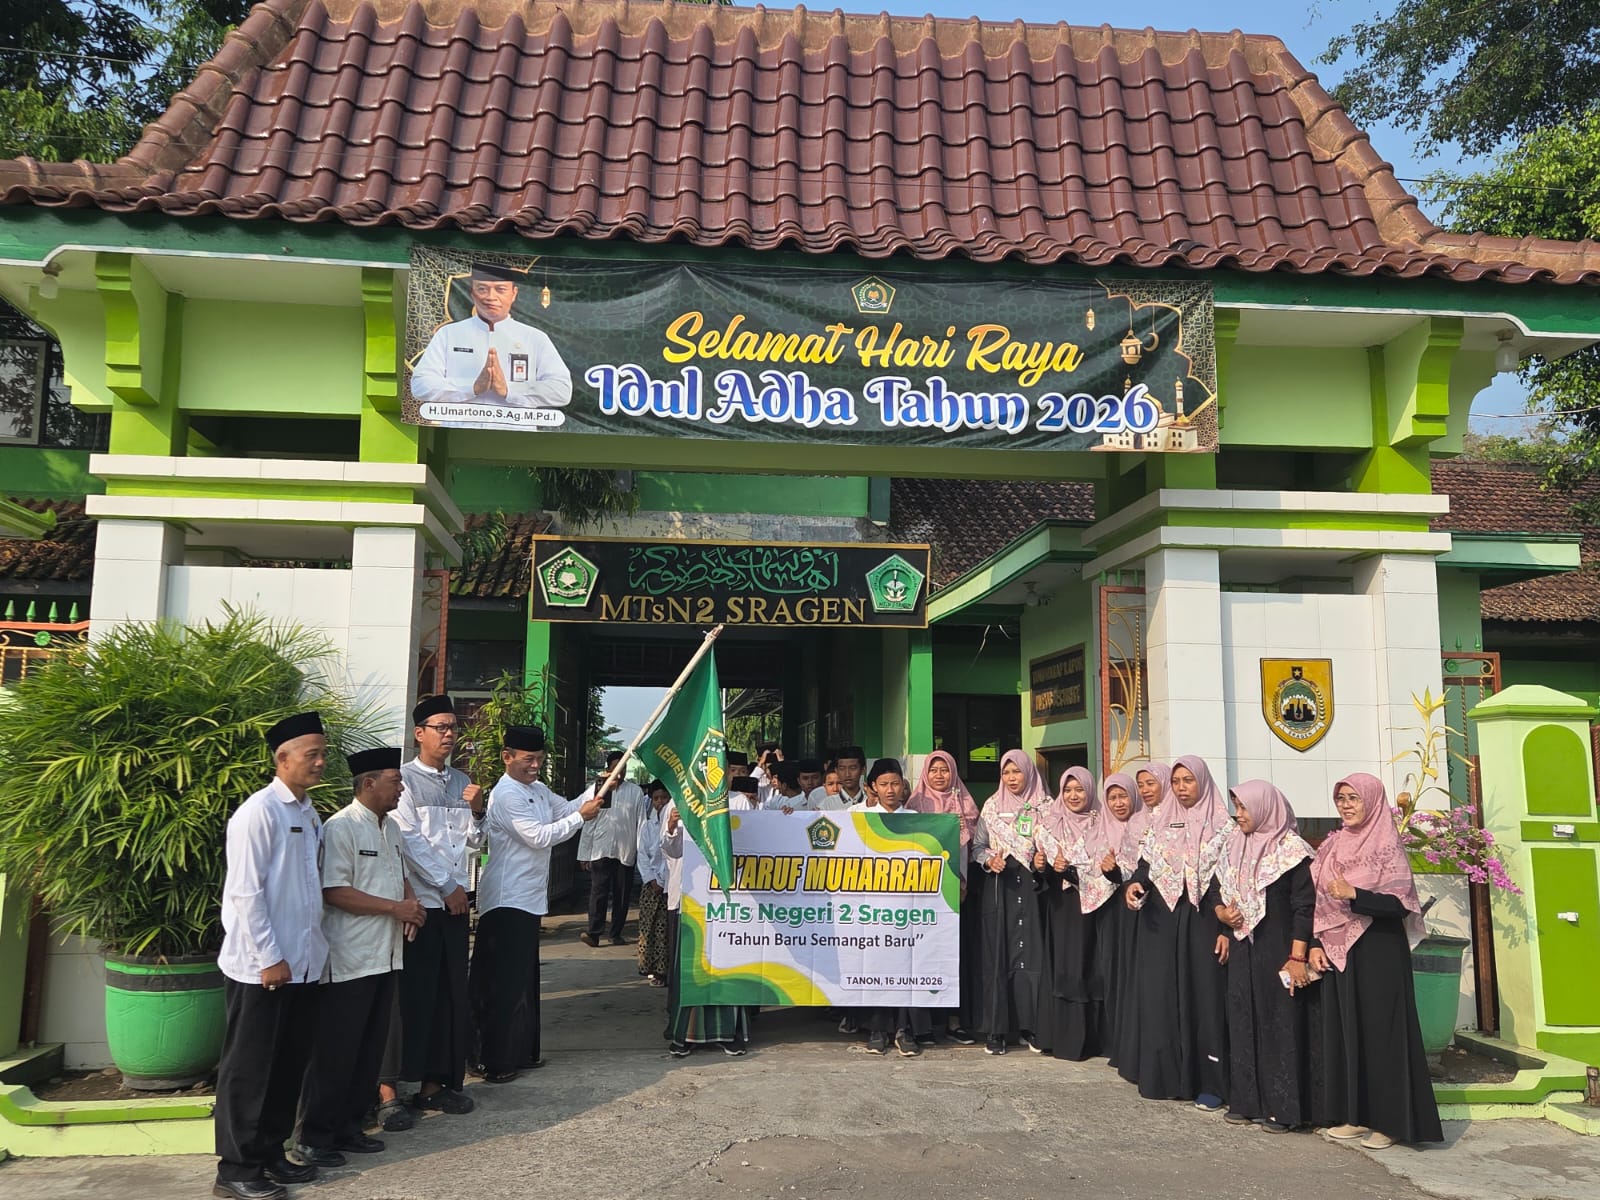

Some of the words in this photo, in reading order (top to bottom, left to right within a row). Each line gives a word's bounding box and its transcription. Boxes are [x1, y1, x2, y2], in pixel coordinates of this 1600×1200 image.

[662, 311, 854, 364] Selamat
[855, 322, 957, 368] Hari
[966, 323, 1085, 388] Raya
[584, 363, 703, 420] Idul
[707, 368, 857, 428] Adha
[863, 374, 1030, 434] Tahun
[1036, 383, 1160, 434] 2026
[726, 597, 867, 624] SRAGEN
[803, 855, 943, 893] MUHARRAM
[706, 902, 752, 922] MTs
[758, 902, 833, 926] Negeri
[839, 903, 853, 922] 2
[858, 904, 937, 928] Sragen
[774, 933, 807, 946] Baru
[810, 933, 880, 950] Semangat
[846, 976, 883, 986] TANON,
[885, 976, 895, 985] 16
[897, 976, 918, 986] JUNI
[919, 976, 943, 986] 2026
